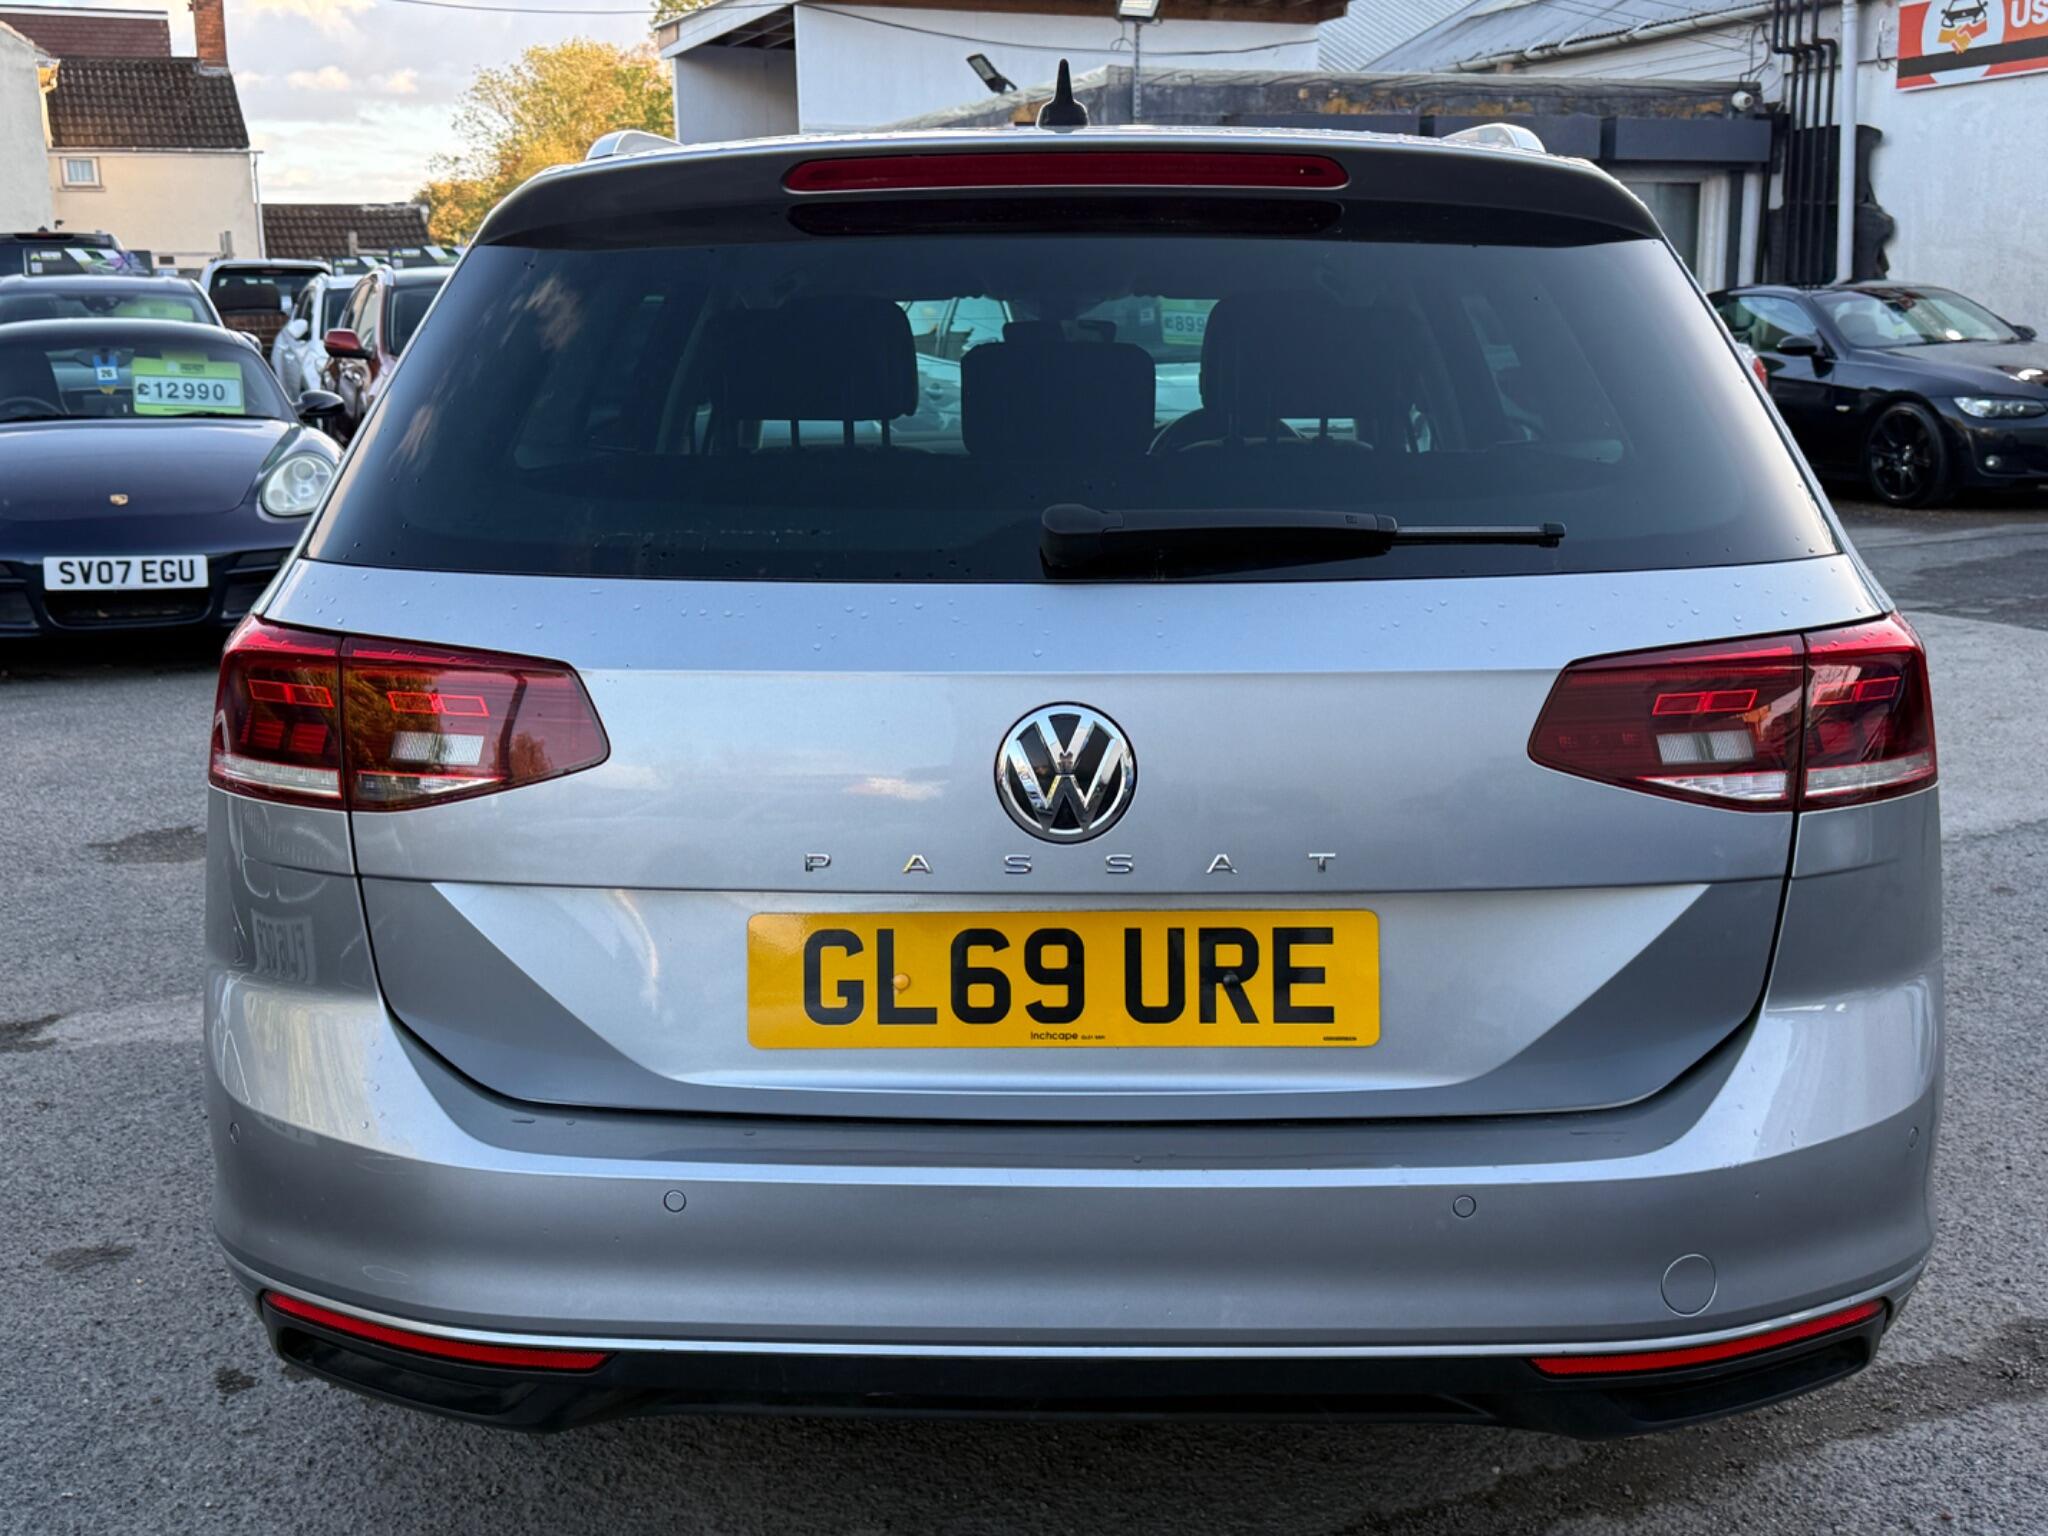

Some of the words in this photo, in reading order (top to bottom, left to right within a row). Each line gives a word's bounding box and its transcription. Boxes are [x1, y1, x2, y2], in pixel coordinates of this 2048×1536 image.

[137, 382, 226, 400] £12990
[58, 560, 132, 585] SV07
[141, 559, 196, 584] EGU
[804, 853, 1339, 874] PASSAT
[803, 928, 1085, 1026] GL69
[1124, 927, 1335, 1025] URE
